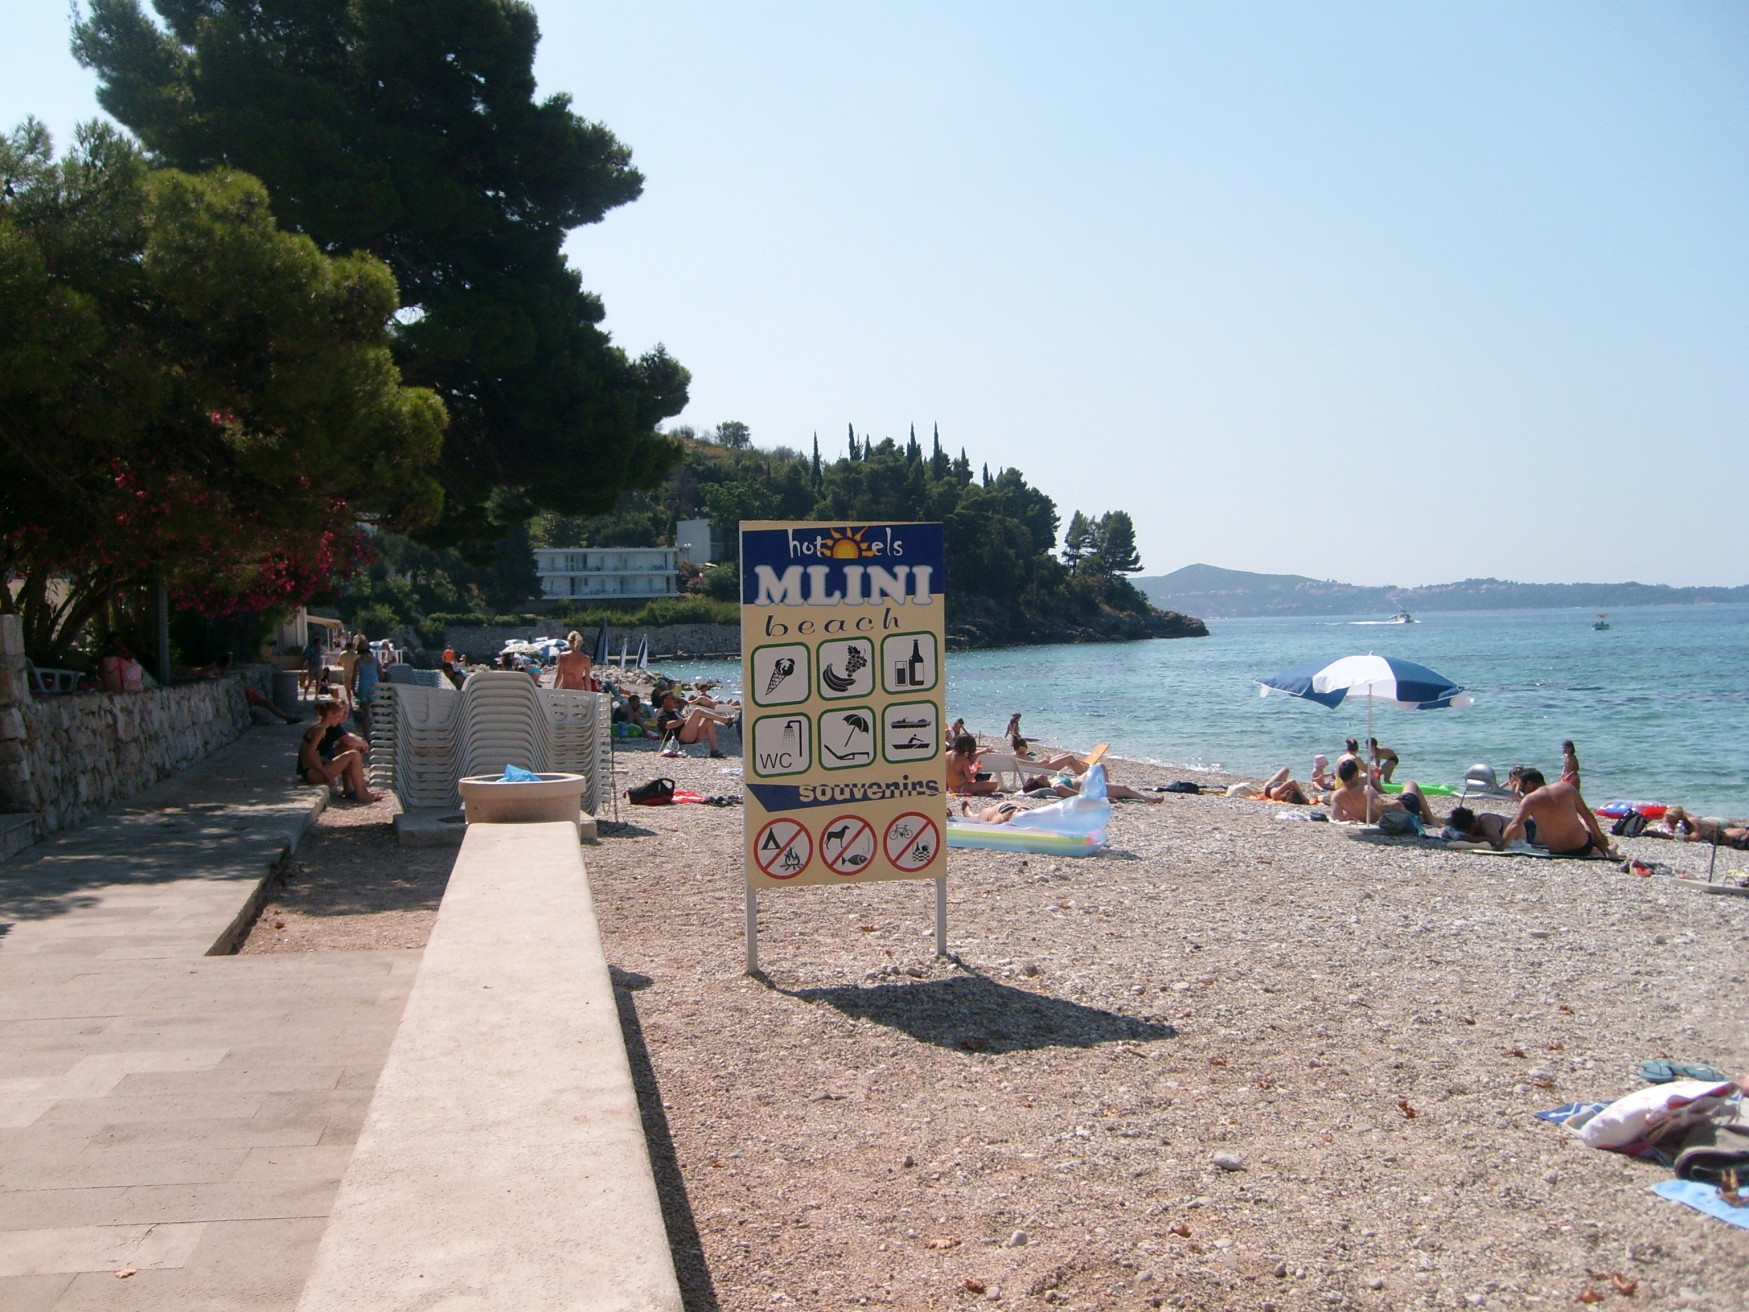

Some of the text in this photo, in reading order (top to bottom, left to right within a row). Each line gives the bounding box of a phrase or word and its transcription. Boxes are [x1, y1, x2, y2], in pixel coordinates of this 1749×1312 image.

[754, 565, 933, 607] MLINI
[765, 608, 900, 637] beach
[760, 753, 793, 769] WC
[799, 775, 940, 802] souvenirs
